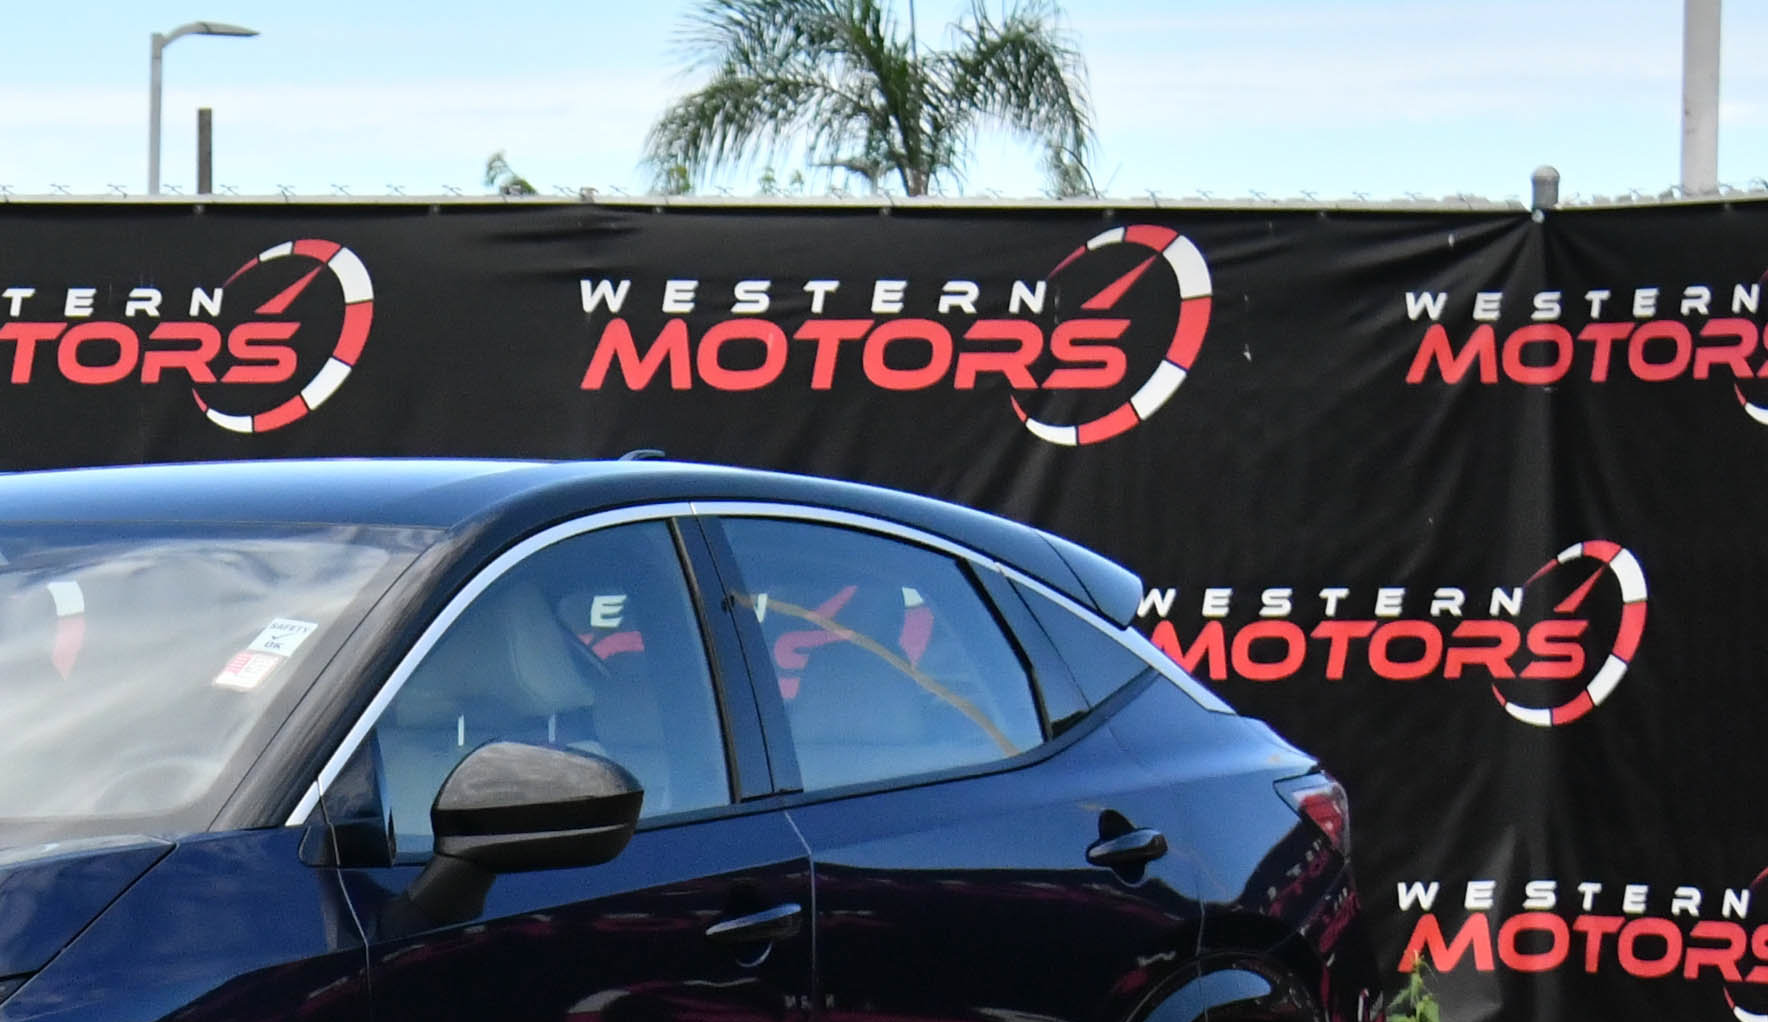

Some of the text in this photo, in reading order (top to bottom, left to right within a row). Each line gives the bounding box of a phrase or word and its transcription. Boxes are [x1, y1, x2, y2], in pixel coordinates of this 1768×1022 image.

[580, 280, 1047, 314] WESTERN
[1405, 283, 1760, 321] WESTERN
[580, 318, 1131, 391] MOTORS
[1405, 318, 1768, 386] MOTOR
[1137, 587, 1524, 618] WESTERN
[1150, 620, 1589, 682] MOTORS
[1397, 880, 1750, 919] WESTERN
